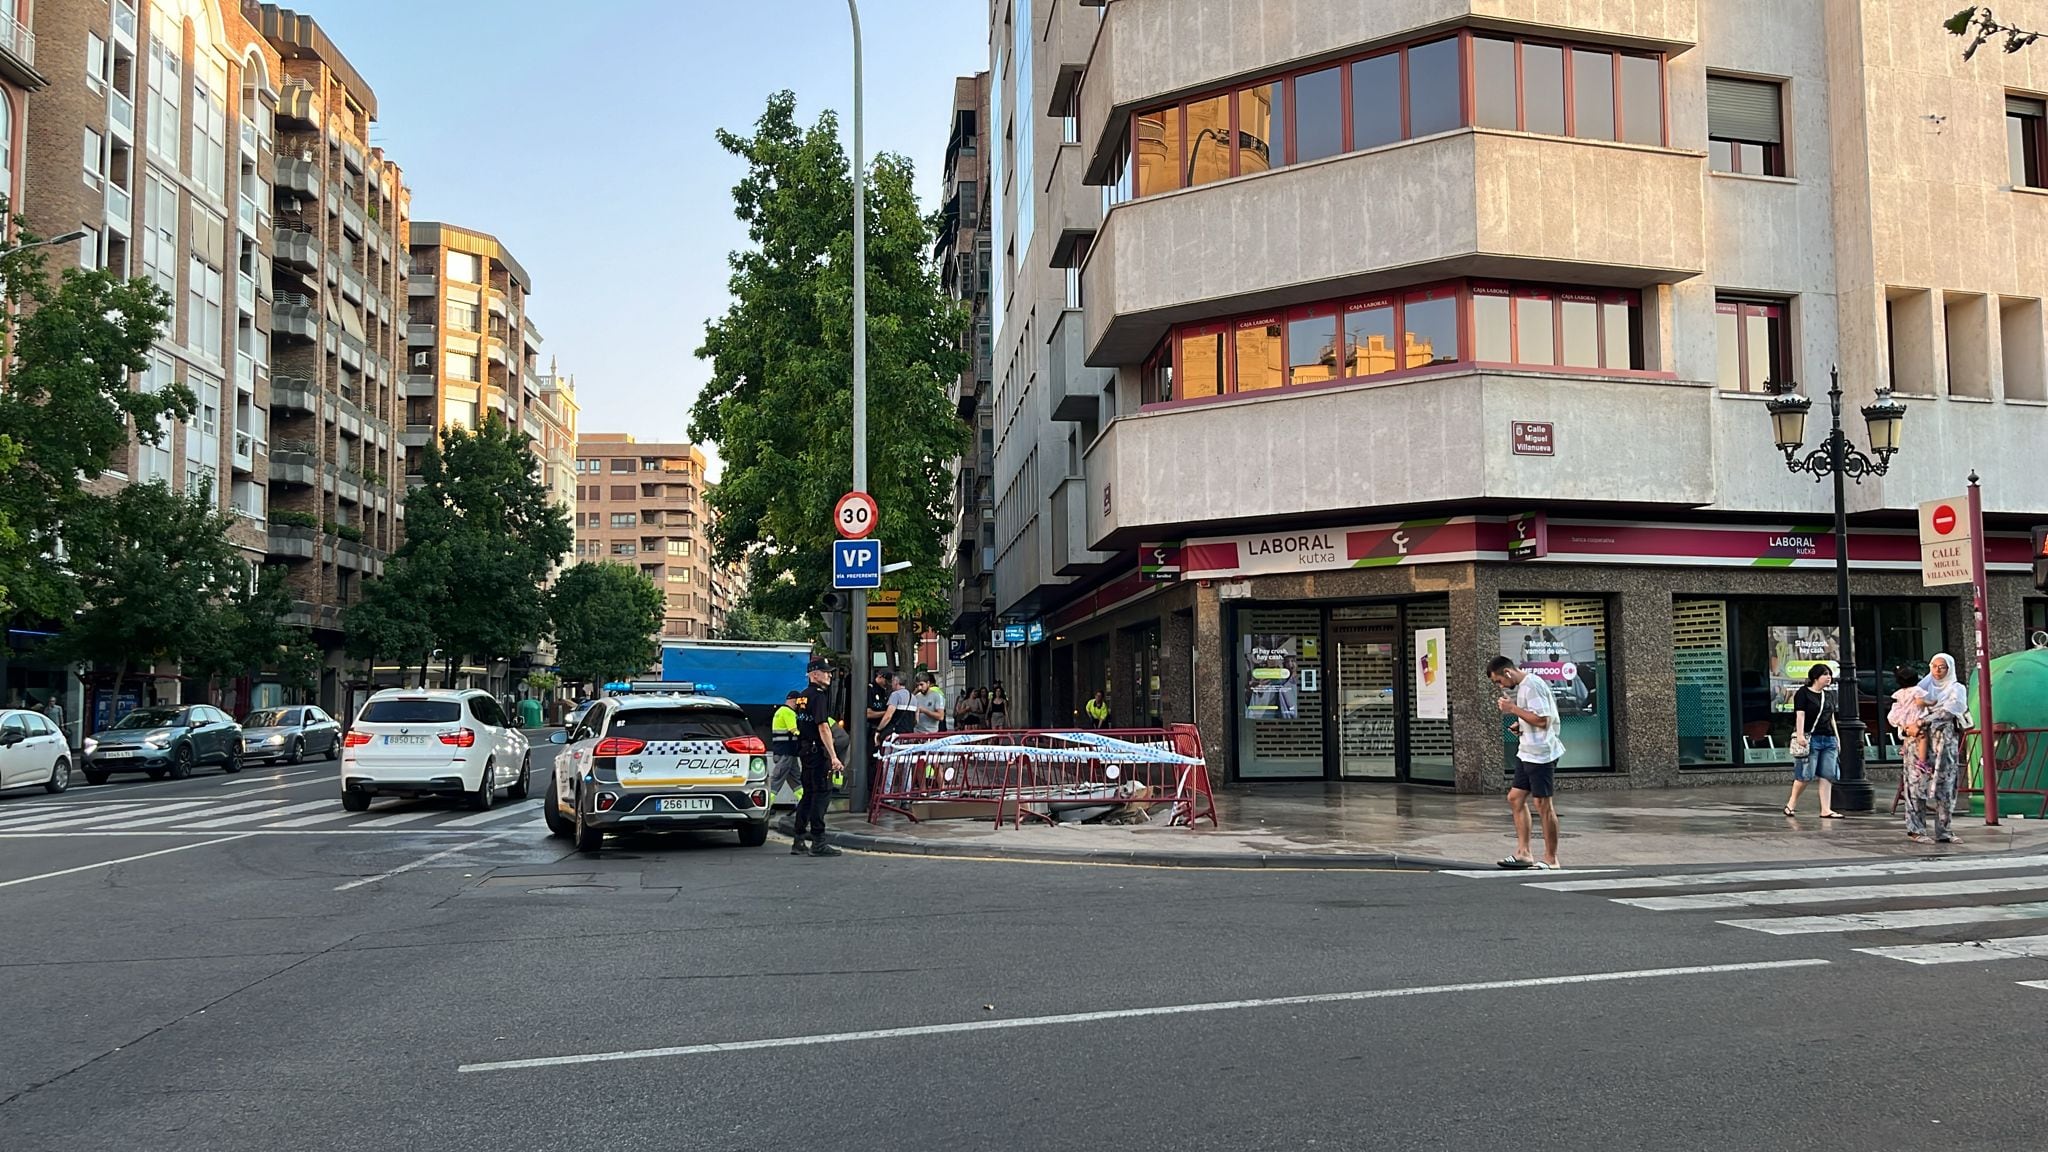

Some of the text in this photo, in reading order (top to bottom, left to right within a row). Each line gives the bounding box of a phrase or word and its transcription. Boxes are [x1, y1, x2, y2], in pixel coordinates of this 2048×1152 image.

[1349, 300, 1388, 311] CAJA LABORAL
[1240, 318, 1276, 328] CAJA LABORAL
[1527, 425, 1546, 433] Calle
[1524, 434, 1548, 443] Miguel
[1516, 443, 1551, 452] Villanueva
[843, 508, 868, 523] 30
[1248, 534, 1335, 555] LABORAL
[1769, 536, 1816, 547] LABORAL
[1796, 547, 1816, 555] kutxa
[1932, 547, 1961, 558] CALLE
[843, 549, 872, 567] VP
[1299, 552, 1336, 564] kutxa
[1934, 560, 1960, 568] MIGUEL
[1926, 569, 1969, 579] VILLANUEVA
[951, 641, 958, 650] P
[1529, 640, 1552, 648] Mundo,
[410, 735, 425, 744] LTS
[676, 758, 740, 769] POLICIA
[663, 800, 711, 809] 2561 LTV
